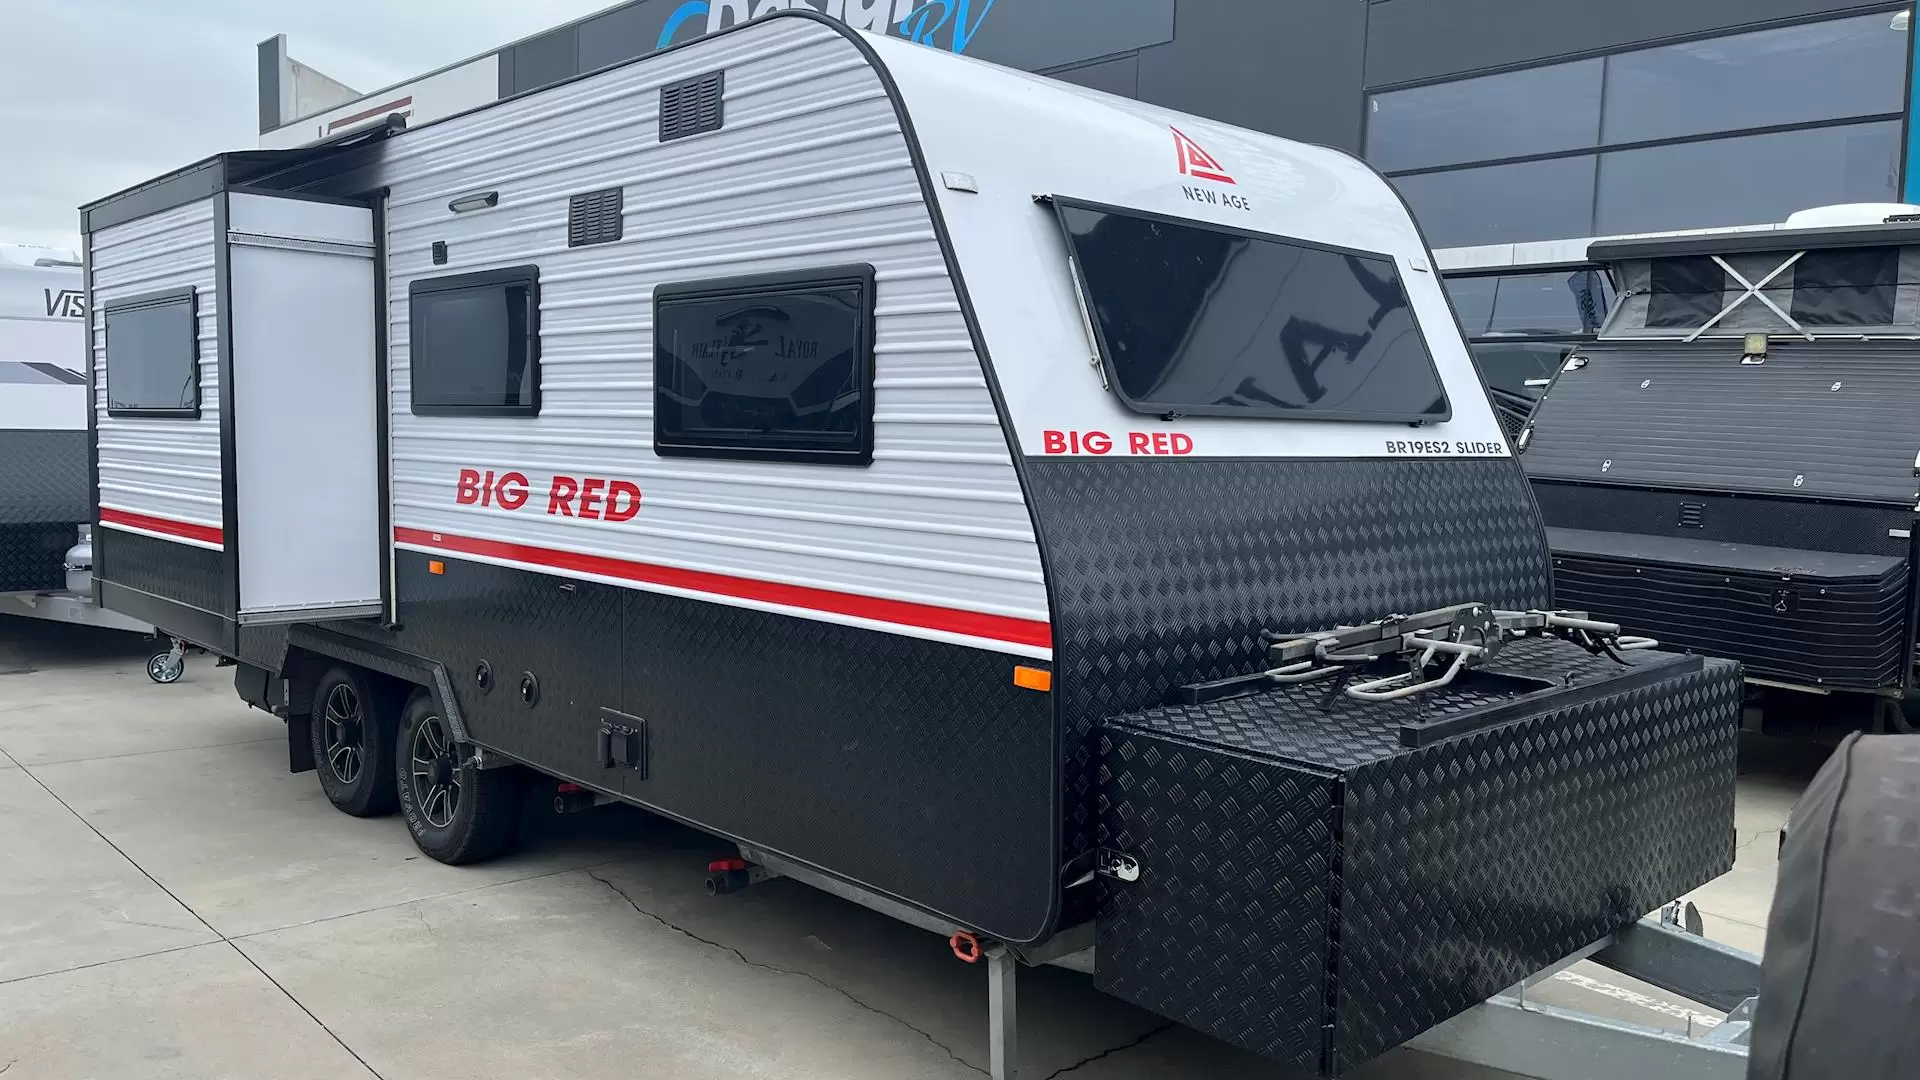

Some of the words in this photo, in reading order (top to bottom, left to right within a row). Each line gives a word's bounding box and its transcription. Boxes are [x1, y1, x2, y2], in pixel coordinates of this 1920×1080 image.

[1181, 185, 1217, 205] NEW
[1222, 193, 1251, 211] AGE
[1043, 430, 1113, 455] BIG
[1128, 432, 1194, 455] RED
[1385, 441, 1451, 454] BR19ES2
[1456, 442, 1504, 454] SLIDER
[456, 468, 530, 511] BIG
[547, 475, 643, 522] RED
